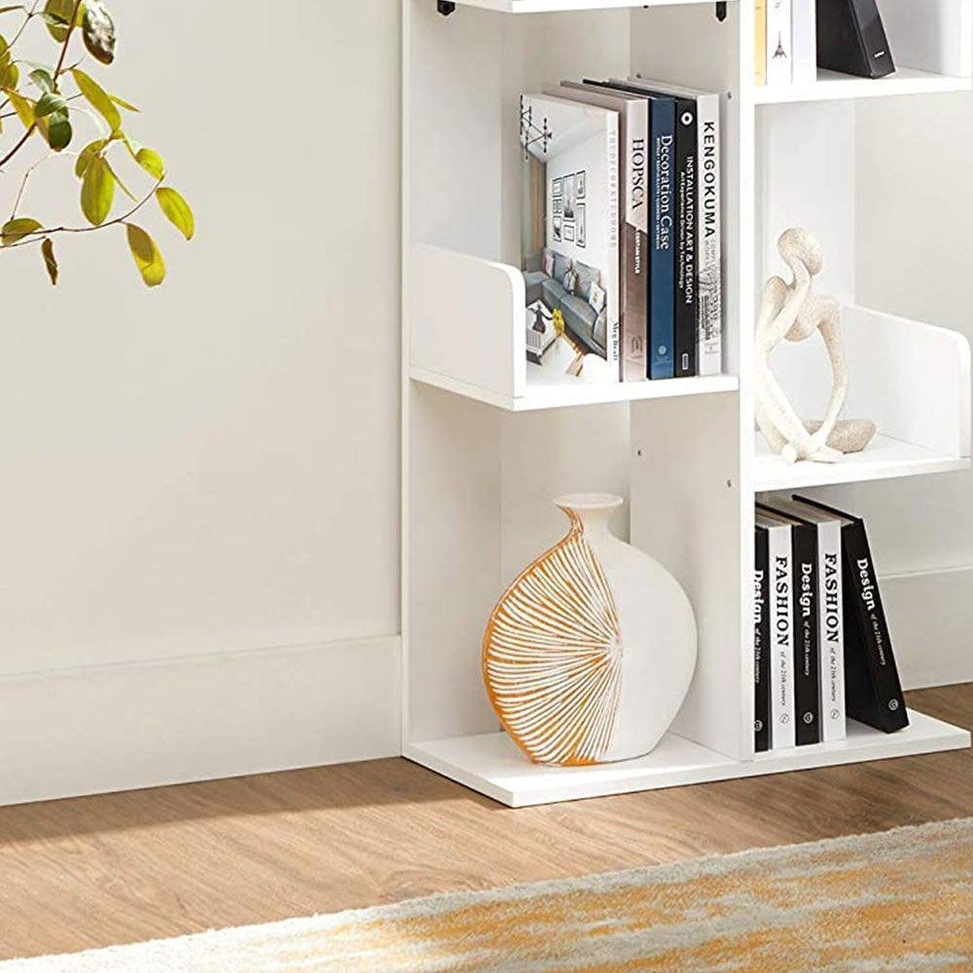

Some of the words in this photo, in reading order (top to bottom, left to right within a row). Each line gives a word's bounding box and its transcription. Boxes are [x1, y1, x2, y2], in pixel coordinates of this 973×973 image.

[632, 138, 645, 210] HOPSCA
[661, 135, 673, 213] Decoration
[685, 156, 694, 230] INSTALLATION
[703, 121, 716, 238] KENGOKUMA
[660, 215, 672, 250] Case
[678, 240, 685, 250] by
[685, 232, 694, 252] ART
[685, 253, 693, 263] &
[685, 264, 693, 304] DESIGN
[755, 570, 764, 624] Design
[776, 556, 789, 646] FASHION
[799, 563, 813, 617] Design
[825, 553, 839, 643] FASHION
[857, 558, 876, 611] Design
